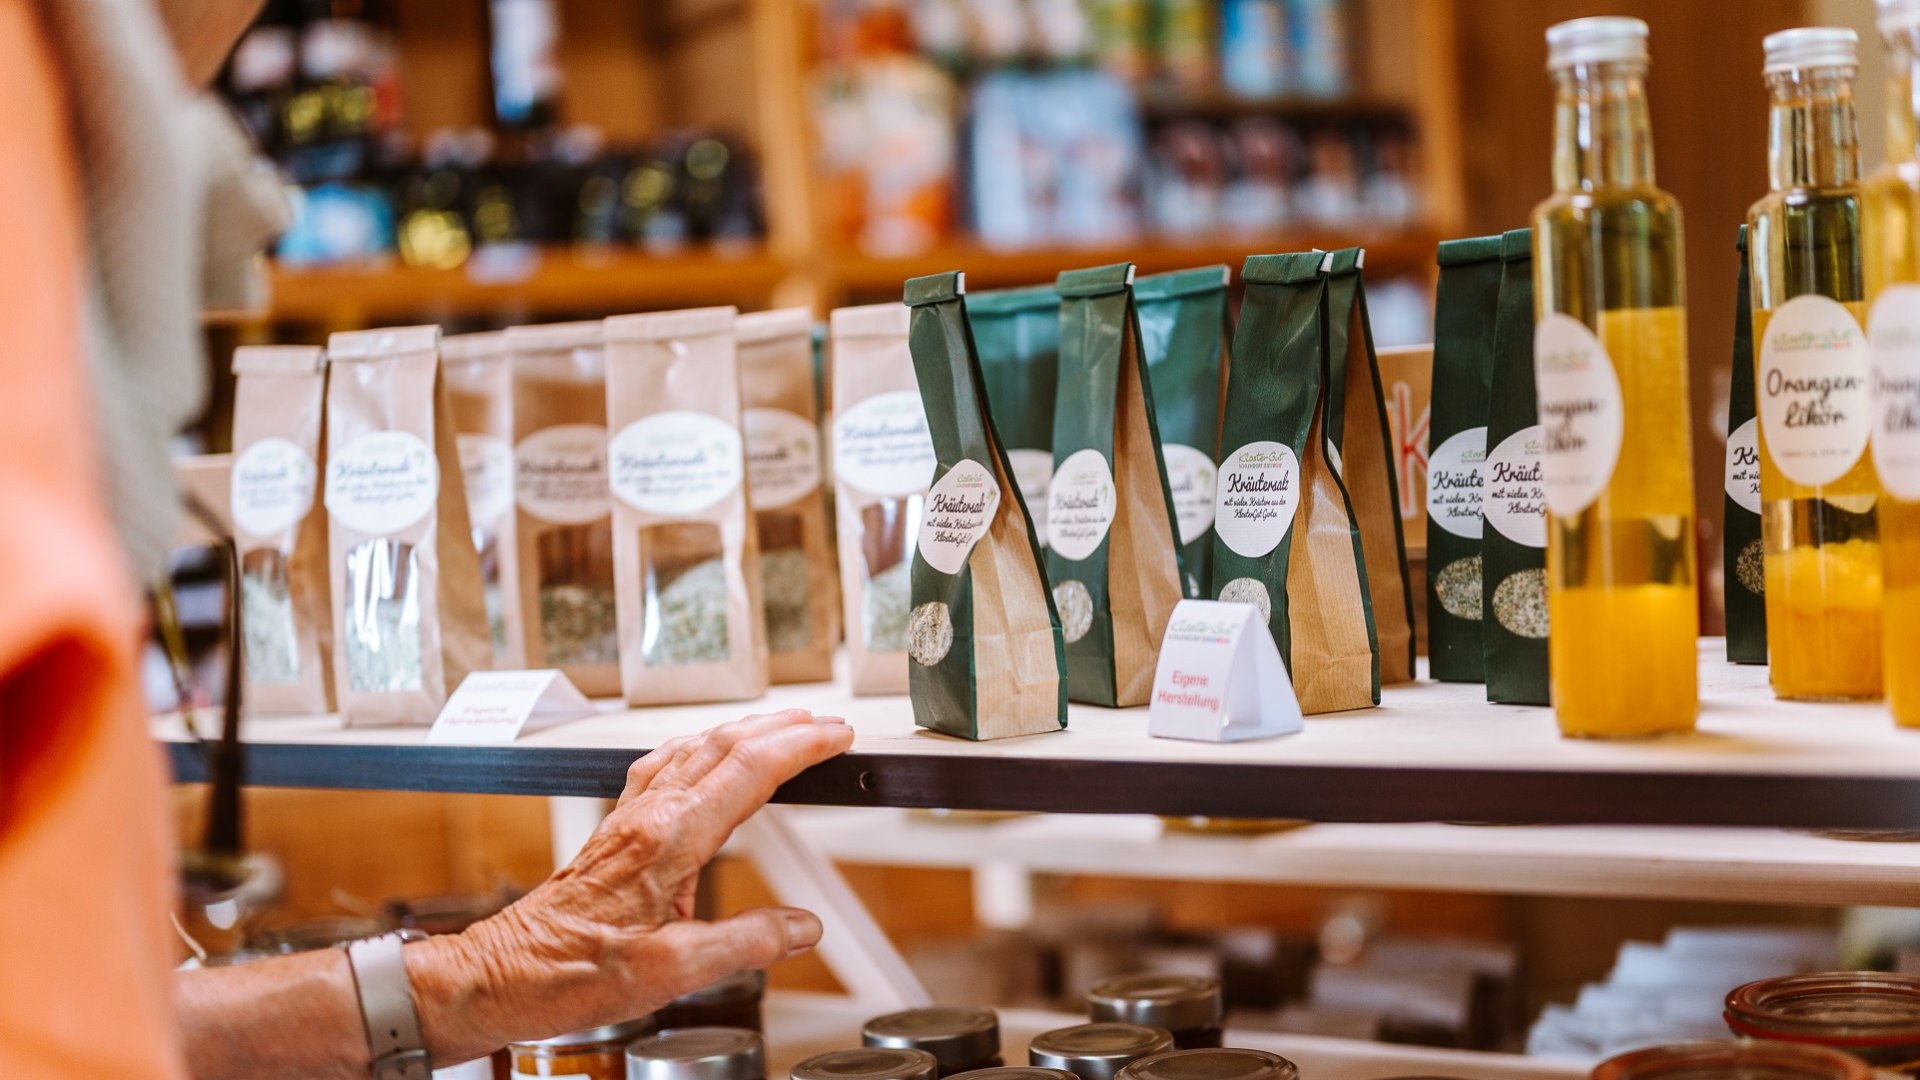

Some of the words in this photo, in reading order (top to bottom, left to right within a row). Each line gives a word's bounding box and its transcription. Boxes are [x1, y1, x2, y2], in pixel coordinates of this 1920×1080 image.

[1784, 401, 1846, 428] Likör
[1227, 470, 1289, 493] Kräutersalz
[1732, 469, 1747, 480] mit
[1433, 494, 1443, 504] mit
[1446, 493, 1465, 503] vielen
[1492, 488, 1504, 499] mit
[1507, 486, 1528, 498] vielen
[1224, 496, 1233, 506] mit
[1234, 496, 1248, 506] vielen
[1171, 670, 1209, 688] Eigene
[1157, 689, 1219, 712] Herstellung
